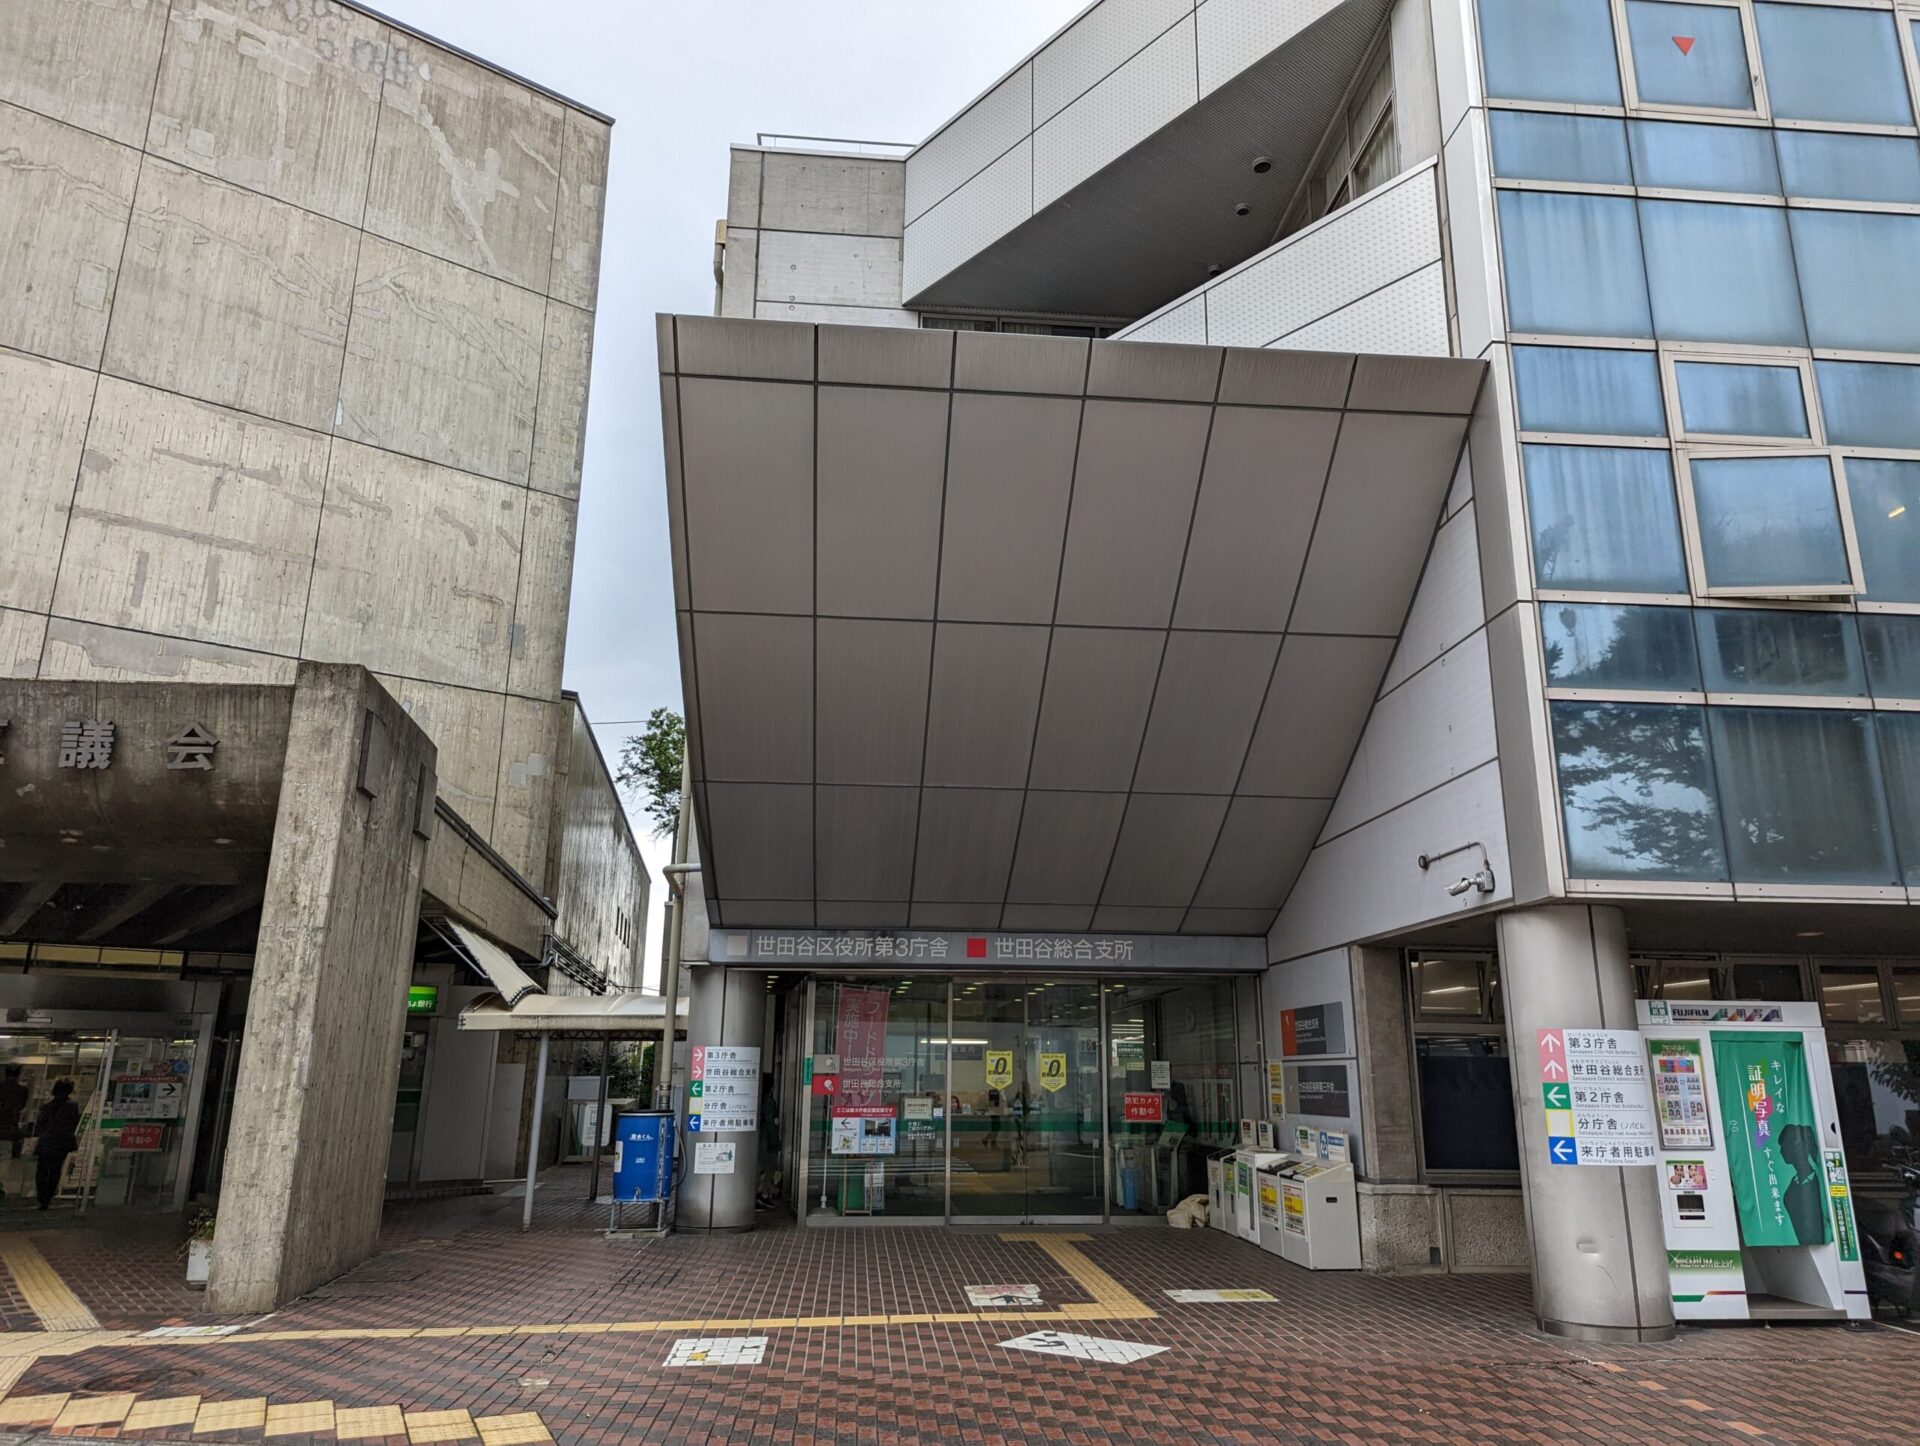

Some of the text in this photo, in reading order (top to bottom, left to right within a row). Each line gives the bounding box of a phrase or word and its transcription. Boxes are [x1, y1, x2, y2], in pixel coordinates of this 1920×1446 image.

[756, 936, 1134, 961] 世田谷区役所第3庁舎 世田谷総合支所
[1672, 1008, 1709, 1017] FUJIFILM
[1720, 1008, 1782, 1020] 証明写真
[1568, 1037, 1617, 1049] 第3庁舎
[995, 1057, 1008, 1075] 0
[1048, 1059, 1061, 1078] 0
[1771, 1060, 1785, 1114] キレイな
[1574, 1092, 1624, 1103] 第2庁舎
[1747, 1064, 1771, 1137] 証明写真
[1131, 1107, 1155, 1116] 作動中
[1578, 1118, 1618, 1130] 分庁舎
[1764, 1147, 1785, 1226] すぐ出来ます
